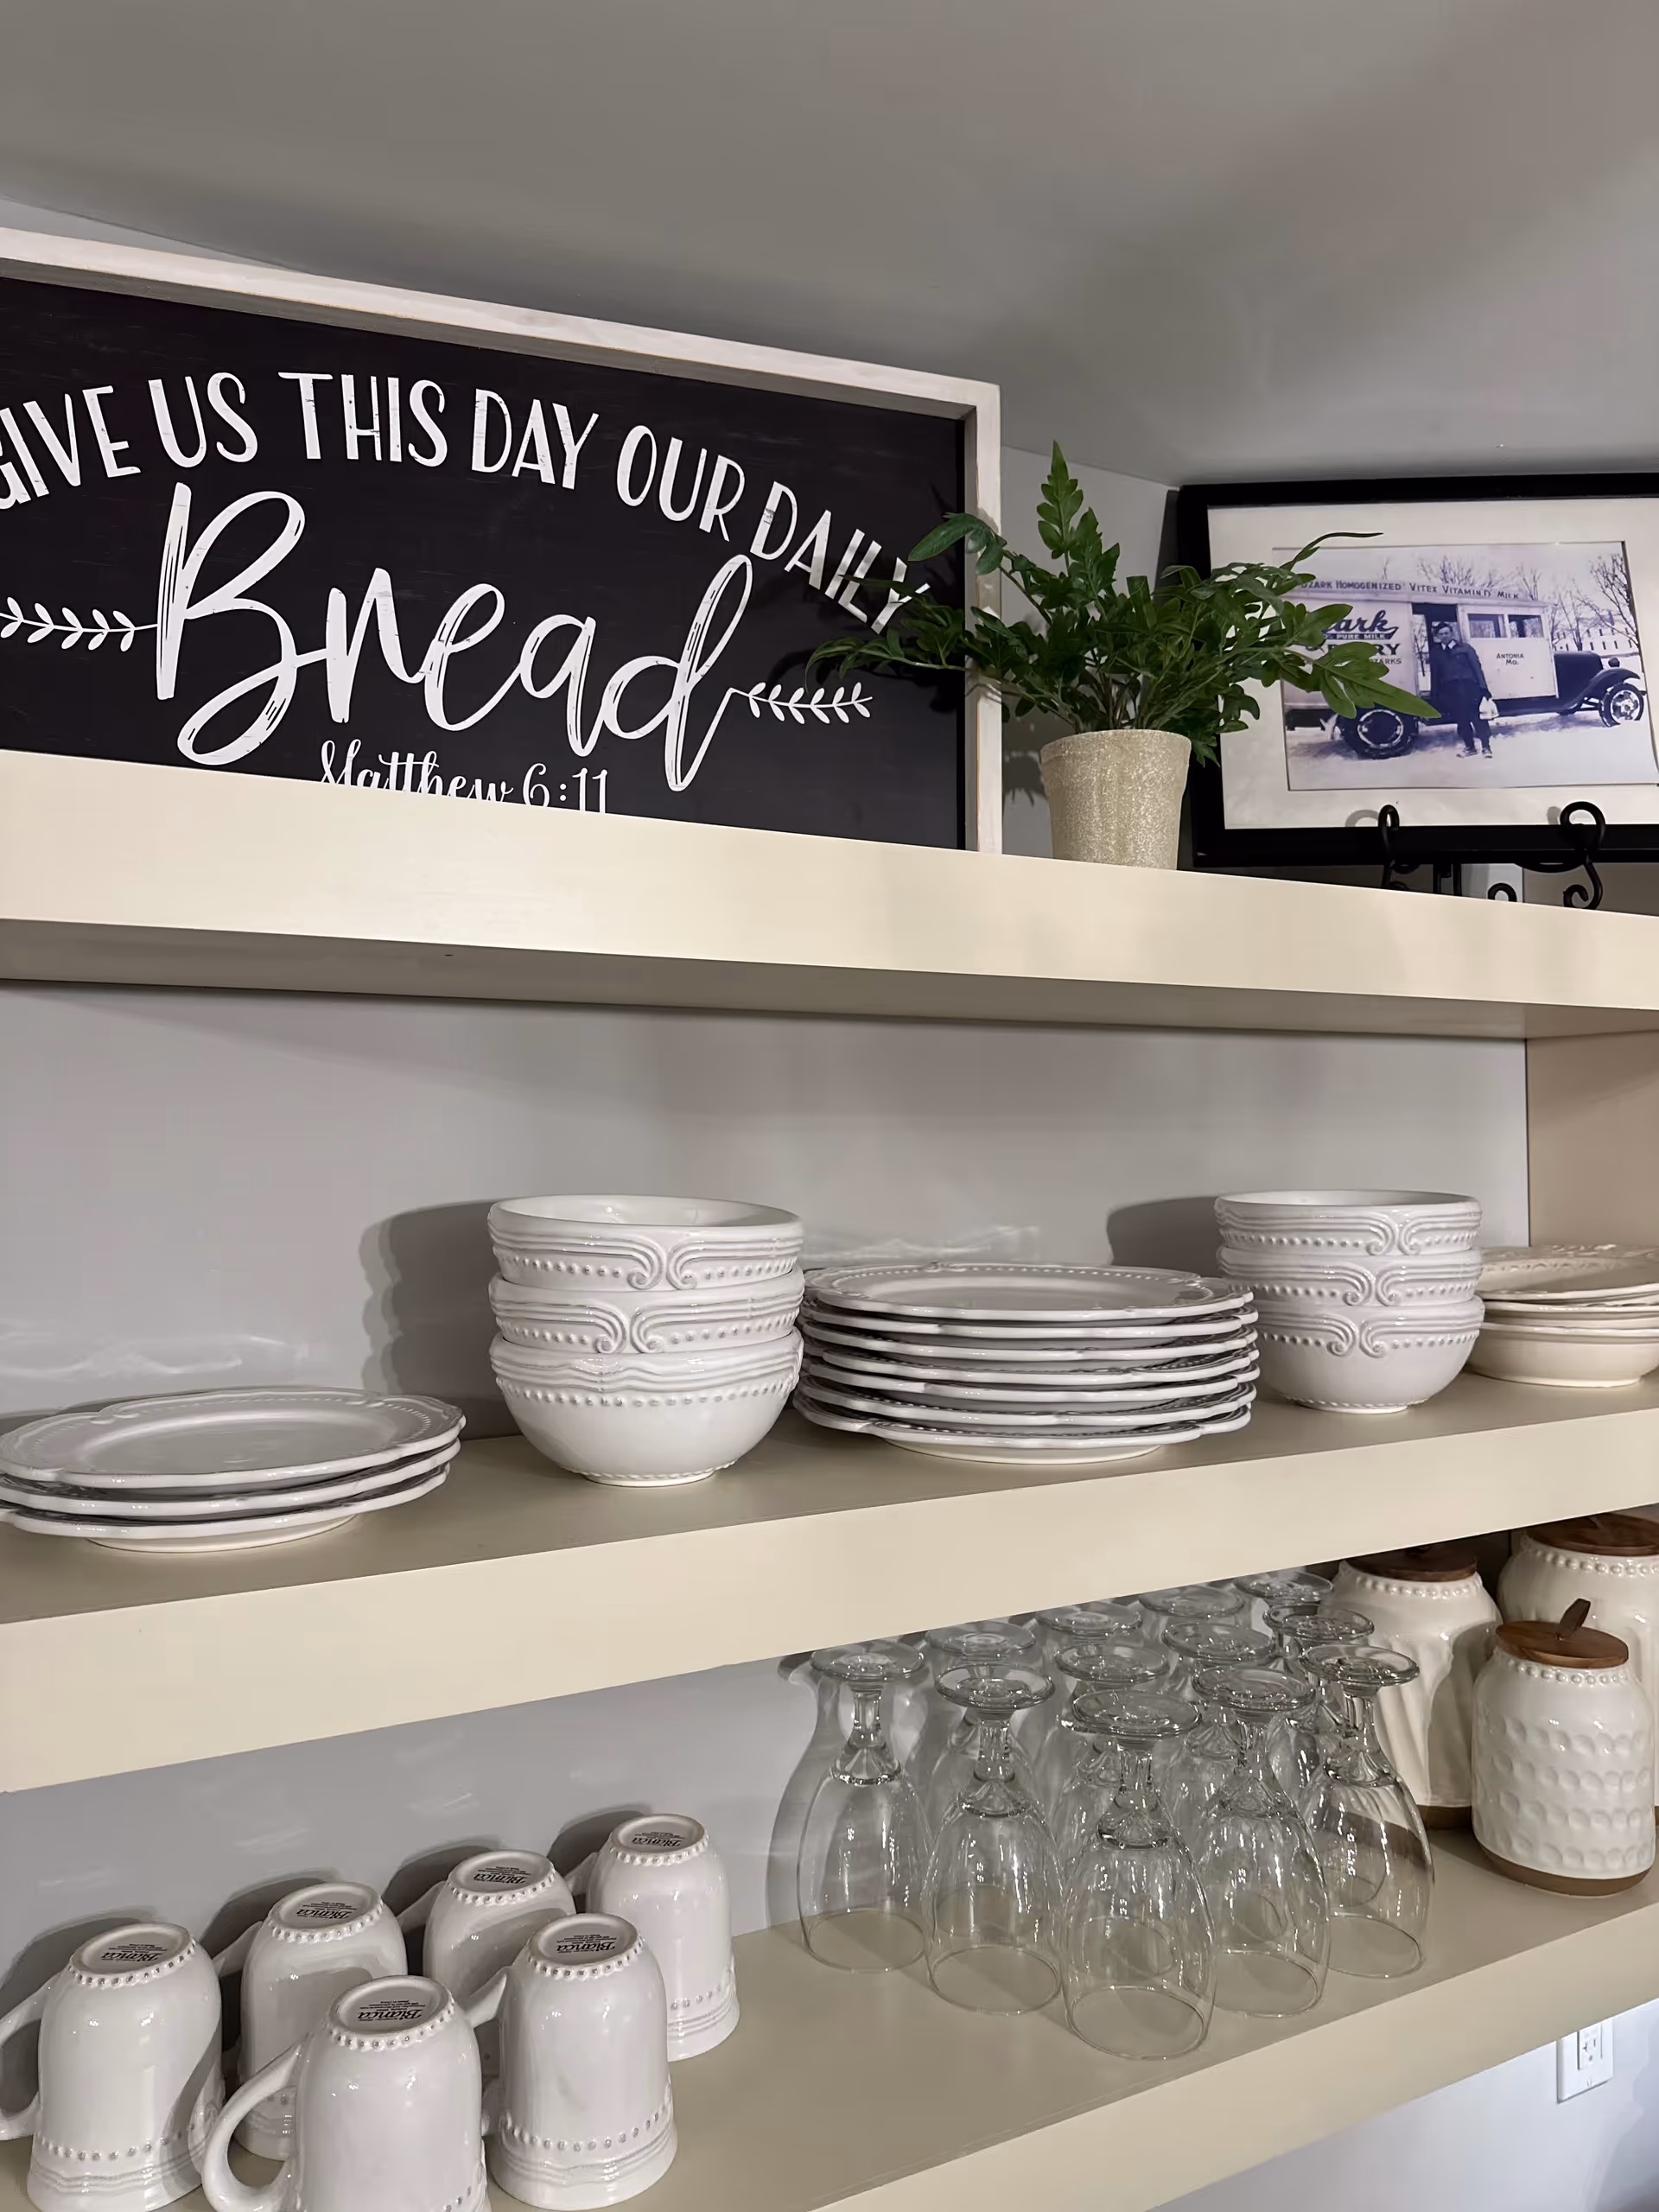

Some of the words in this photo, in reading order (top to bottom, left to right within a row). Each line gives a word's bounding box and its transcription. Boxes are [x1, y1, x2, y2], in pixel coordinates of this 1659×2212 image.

[149, 372, 257, 467] US
[278, 372, 447, 467] THIS
[472, 389, 599, 489] DAY
[617, 426, 745, 541] OUR
[750, 481, 931, 634] DAILY
[1336, 581, 1402, 590] HOMOGENIZED
[1497, 591, 1520, 600] MILK
[156, 482, 753, 791] Bread
[523, 763, 607, 813] 6:11
[556, 1942, 616, 1951] Bianca
[358, 2009, 423, 2020] Bianca
